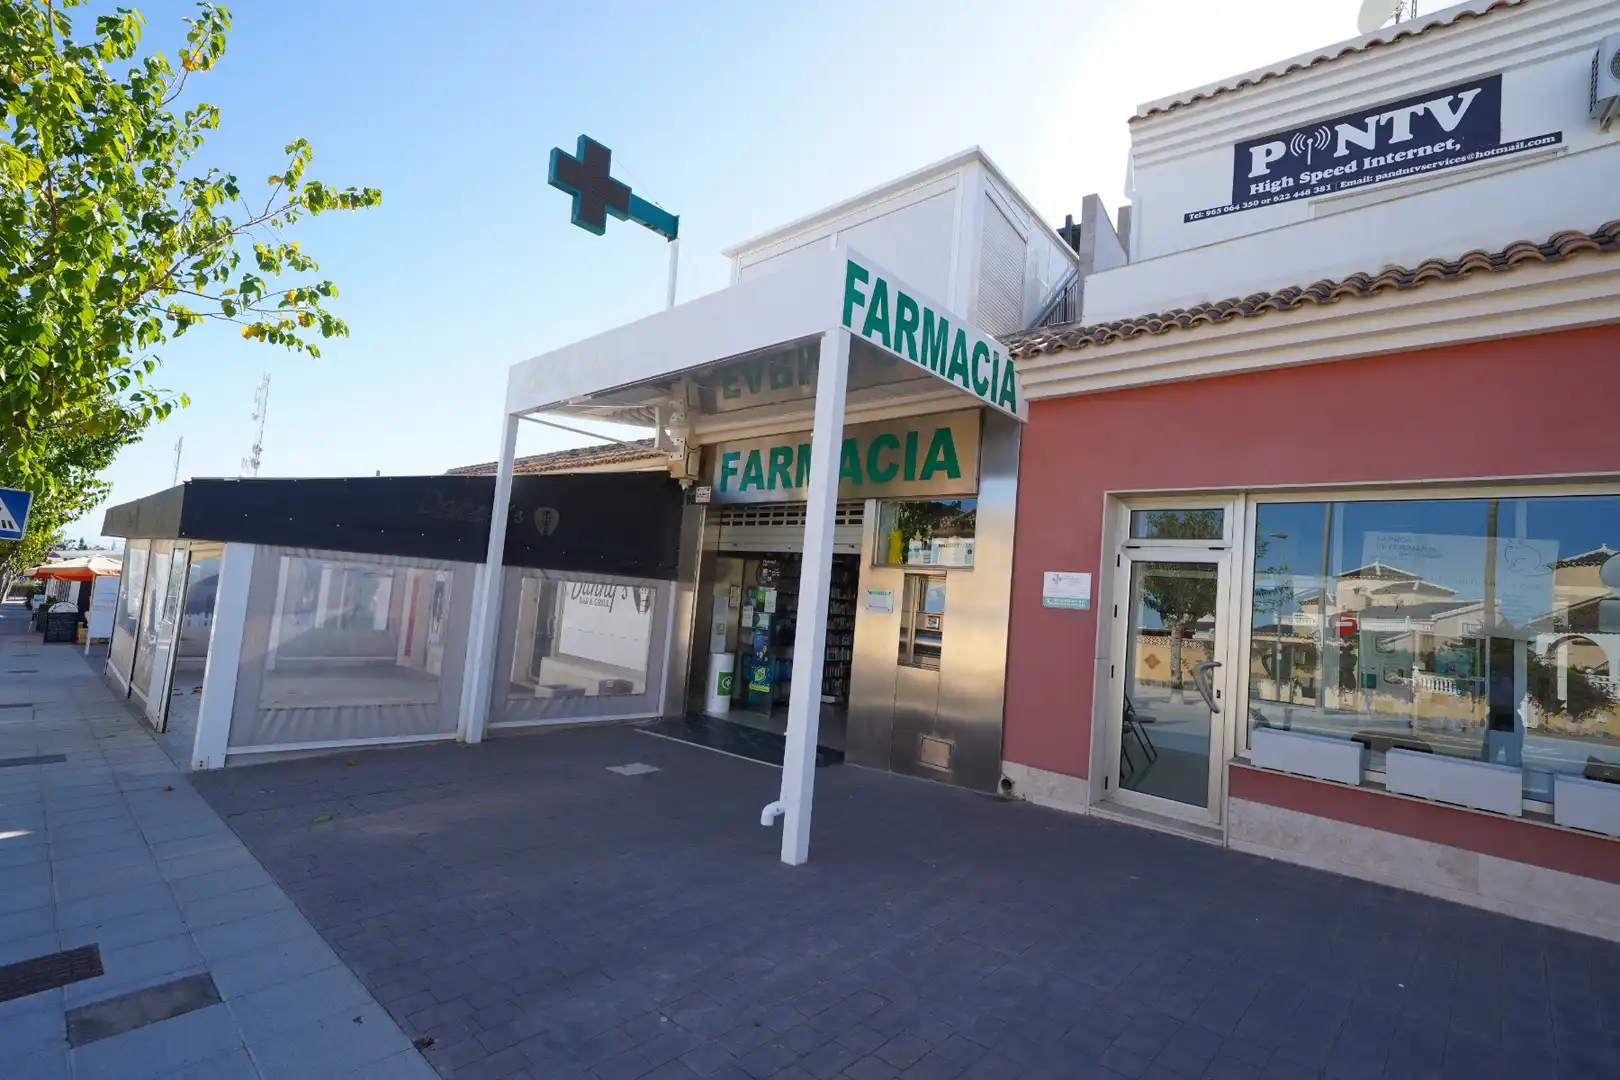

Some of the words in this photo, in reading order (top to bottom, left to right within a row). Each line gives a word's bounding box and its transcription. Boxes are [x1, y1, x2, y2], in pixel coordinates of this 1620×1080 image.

[1188, 211, 1204, 221] Tel:
[1206, 208, 1222, 217] 965
[1223, 204, 1241, 213] 064
[1242, 200, 1259, 209] 350
[1273, 193, 1291, 202] 622
[1292, 188, 1311, 198] 448
[1313, 184, 1331, 194] 381
[1340, 175, 1373, 188] Email:
[1375, 135, 1556, 182] pandntvservices@hotmail.com
[1249, 175, 1294, 196] High
[1299, 159, 1357, 185] Speed
[1362, 138, 1462, 170] Internet,
[842, 259, 1017, 414] FARMACIA
